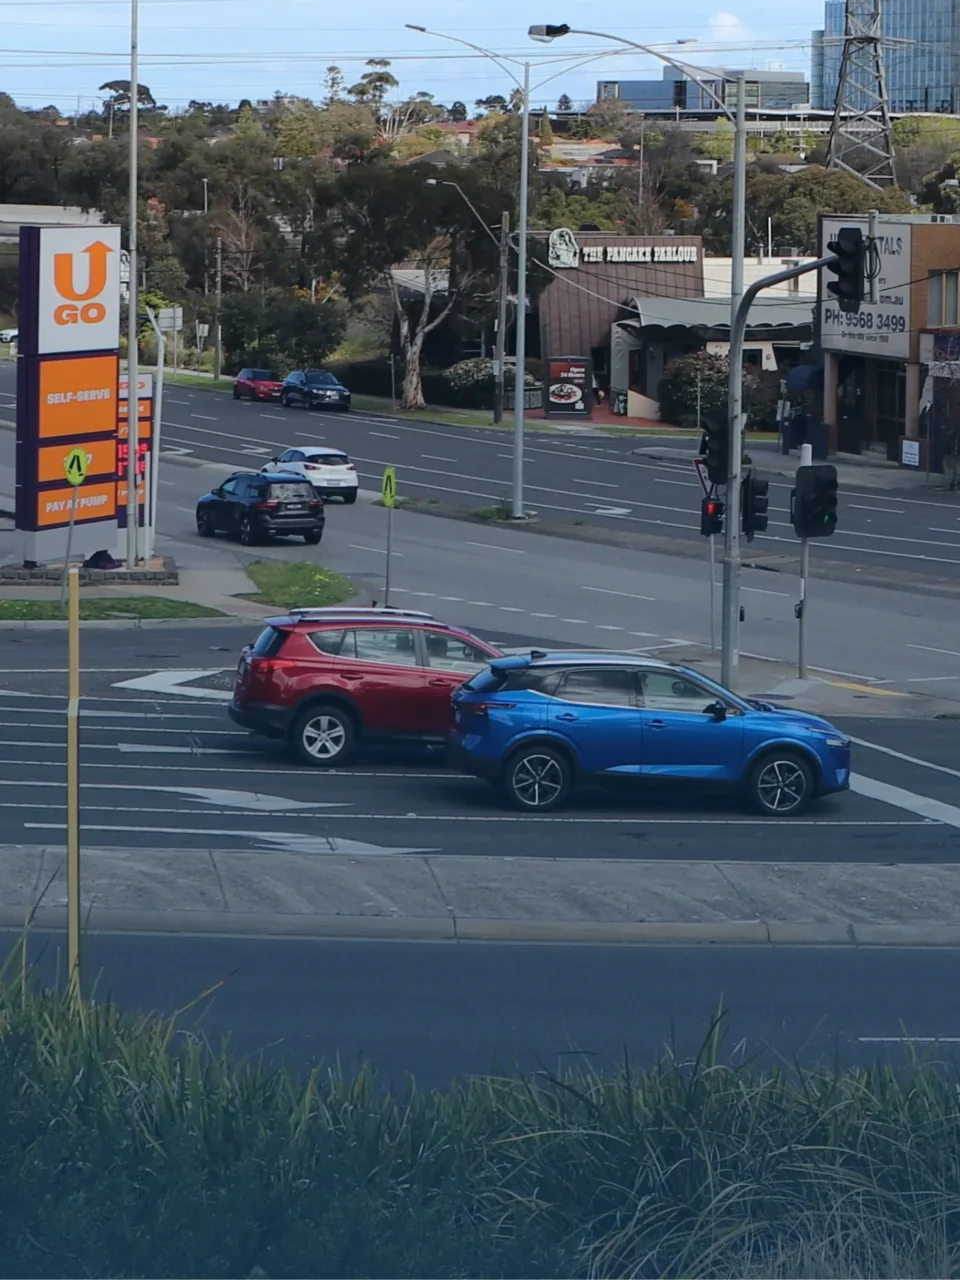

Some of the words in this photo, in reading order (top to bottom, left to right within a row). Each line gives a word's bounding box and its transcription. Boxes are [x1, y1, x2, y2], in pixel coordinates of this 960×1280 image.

[582, 246, 603, 262] THE
[606, 246, 651, 262] PANCAKE
[653, 246, 698, 262] PARLOUR
[53, 302, 107, 326] GO
[825, 308, 843, 326] PH:
[845, 310, 874, 329] 9568
[876, 313, 906, 333] 3499
[47, 388, 111, 405] SELF-SERVE
[46, 500, 66, 513] PAY
[80, 494, 108, 508] PUMP
